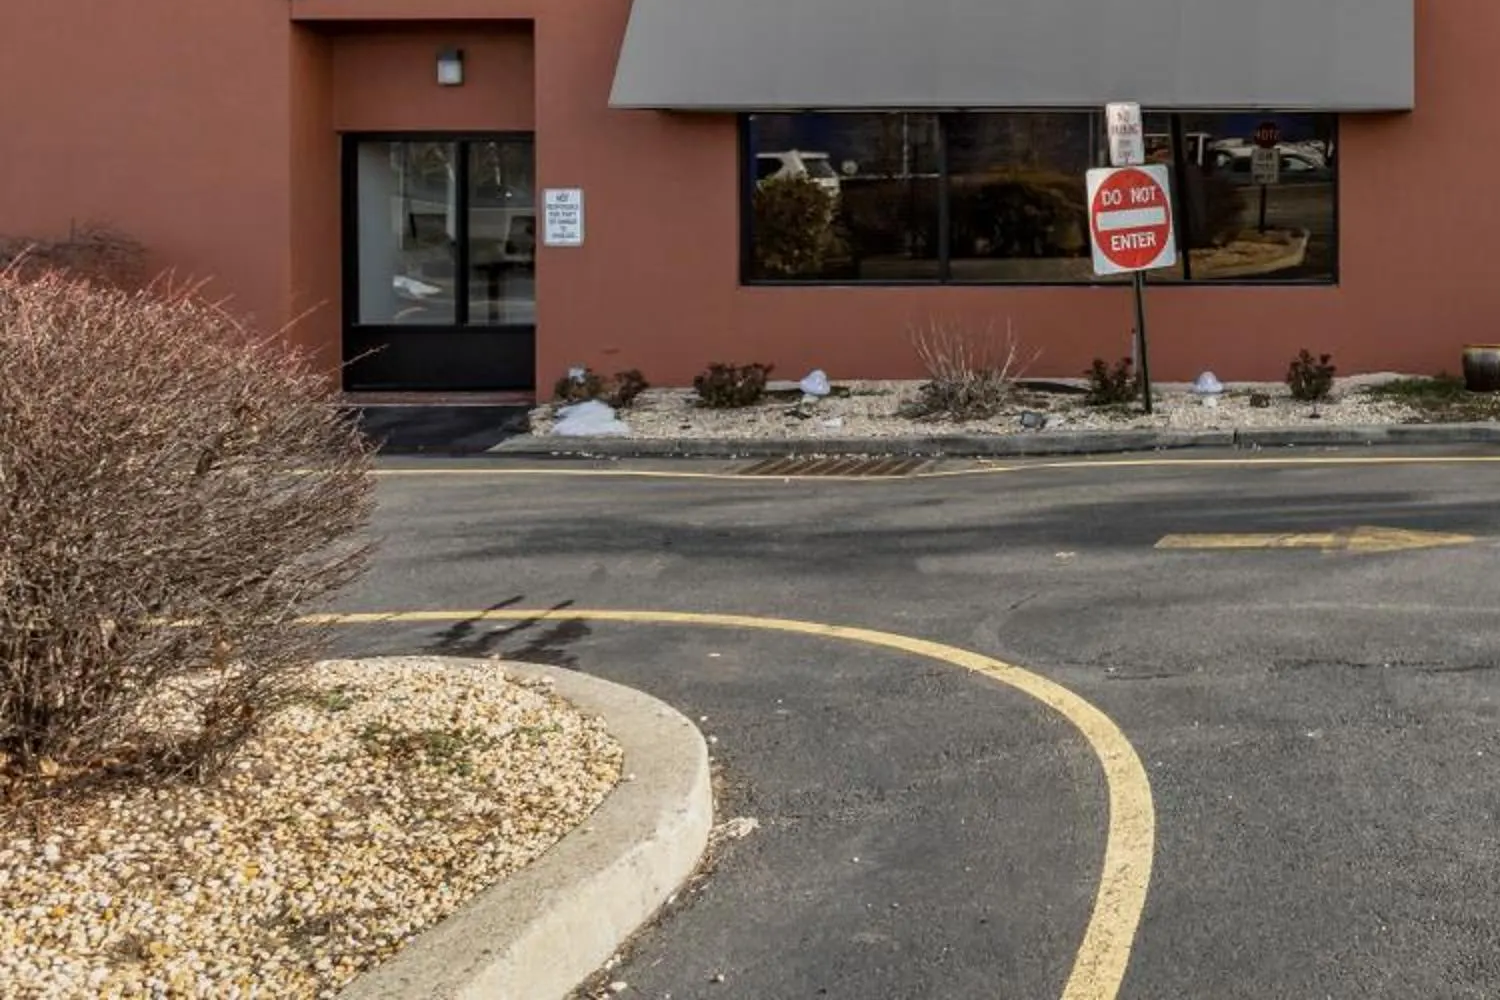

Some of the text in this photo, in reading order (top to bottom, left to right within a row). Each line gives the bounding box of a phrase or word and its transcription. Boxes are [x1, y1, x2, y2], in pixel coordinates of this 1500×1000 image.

[1101, 186, 1156, 205] DO NOT
[1110, 231, 1157, 251] ENTER
